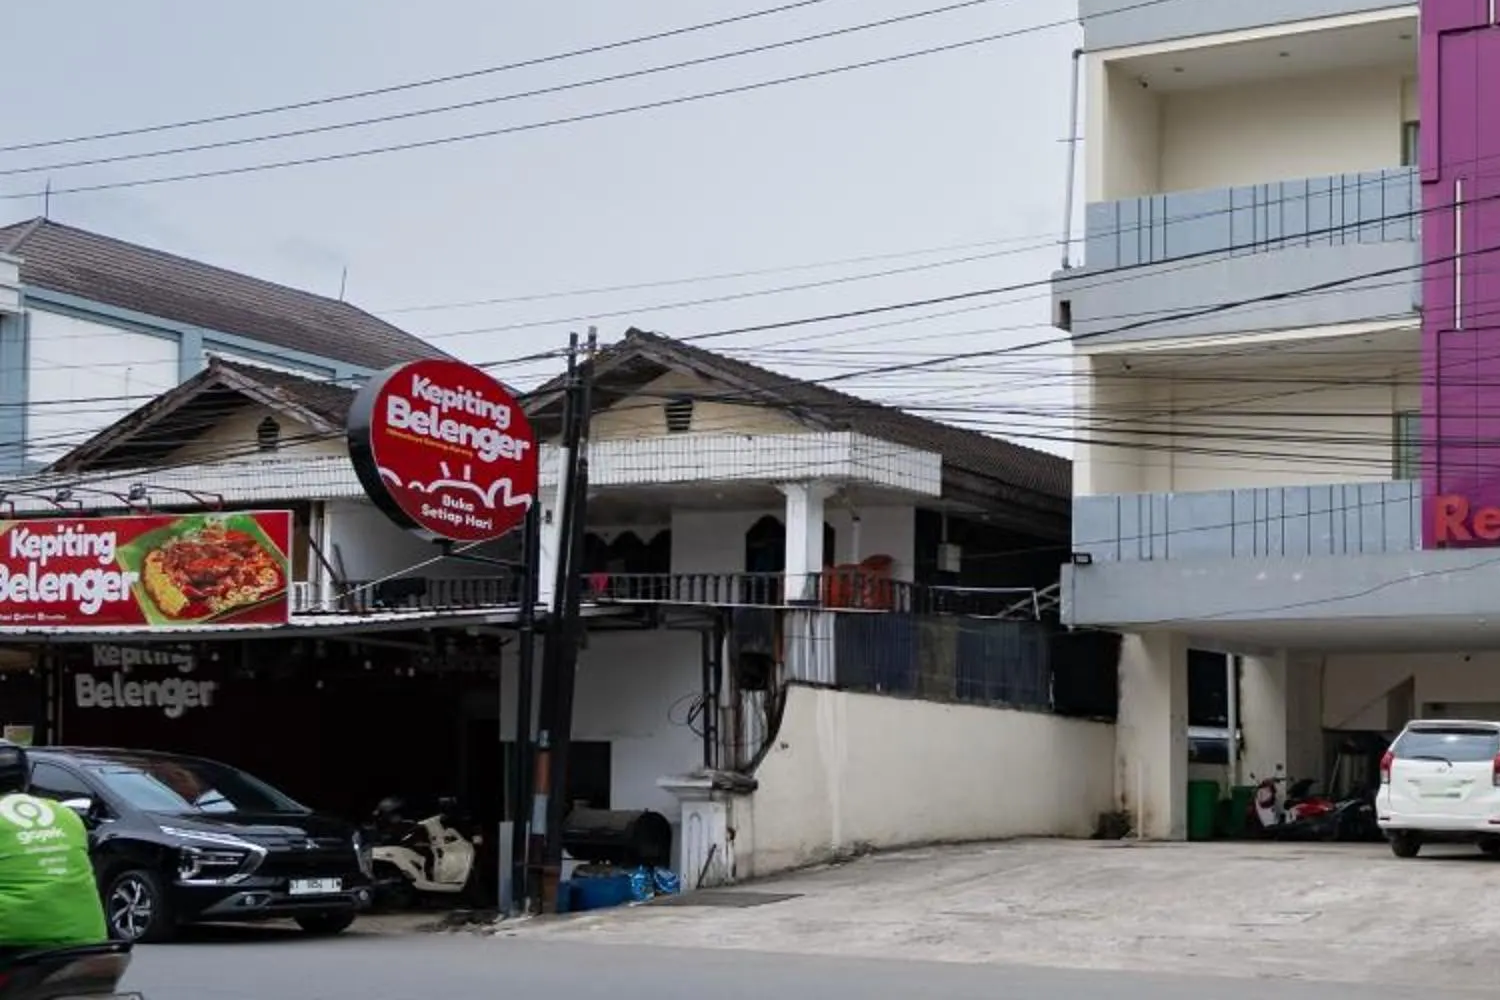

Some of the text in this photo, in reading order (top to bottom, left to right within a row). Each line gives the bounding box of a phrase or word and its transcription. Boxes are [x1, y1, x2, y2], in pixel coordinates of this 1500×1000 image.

[411, 373, 511, 430] Kepiting
[386, 394, 530, 462] Belenger
[421, 503, 493, 530] Setiap Hari
[442, 494, 475, 512] Buka
[10, 523, 117, 567] Kepiting
[75, 671, 216, 718] Belenger
